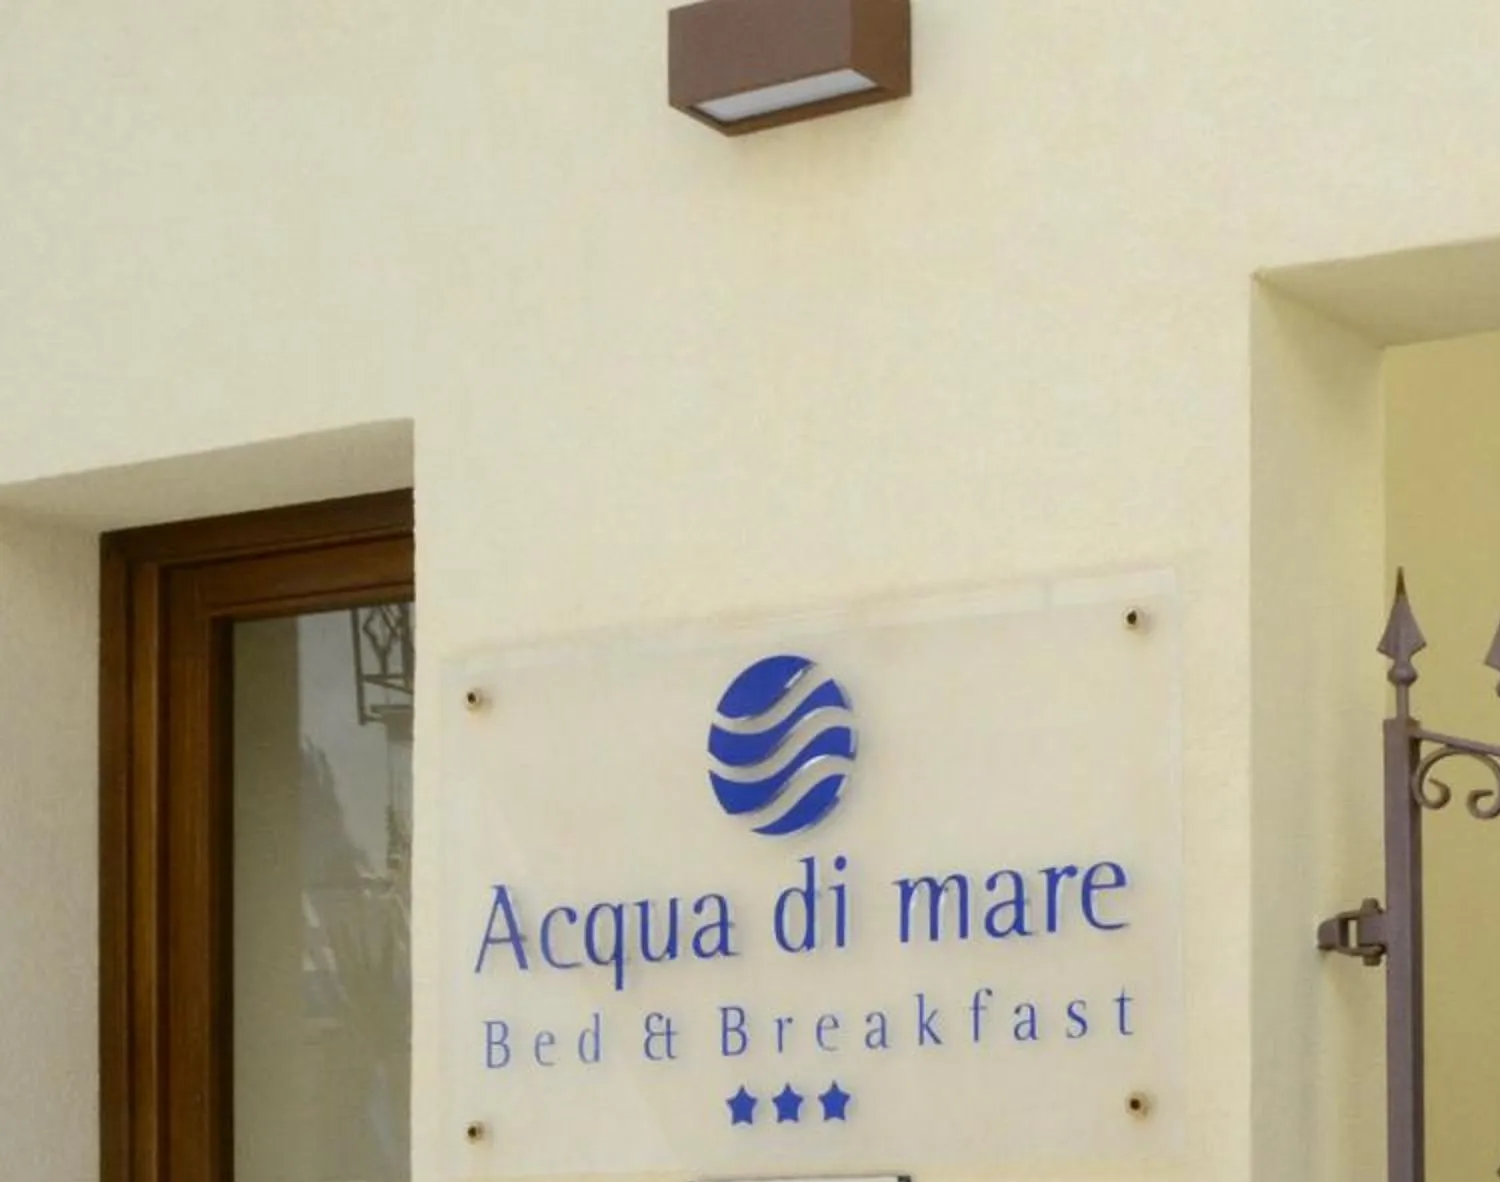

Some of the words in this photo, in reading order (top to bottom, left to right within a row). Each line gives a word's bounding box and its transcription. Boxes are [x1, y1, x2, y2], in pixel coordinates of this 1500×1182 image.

[476, 883, 736, 991] Acqua
[773, 855, 850, 953] di
[891, 858, 1130, 944] mare
[485, 1014, 602, 1070] Bed
[643, 1014, 679, 1061] &
[720, 987, 1134, 1058] Breakfast
